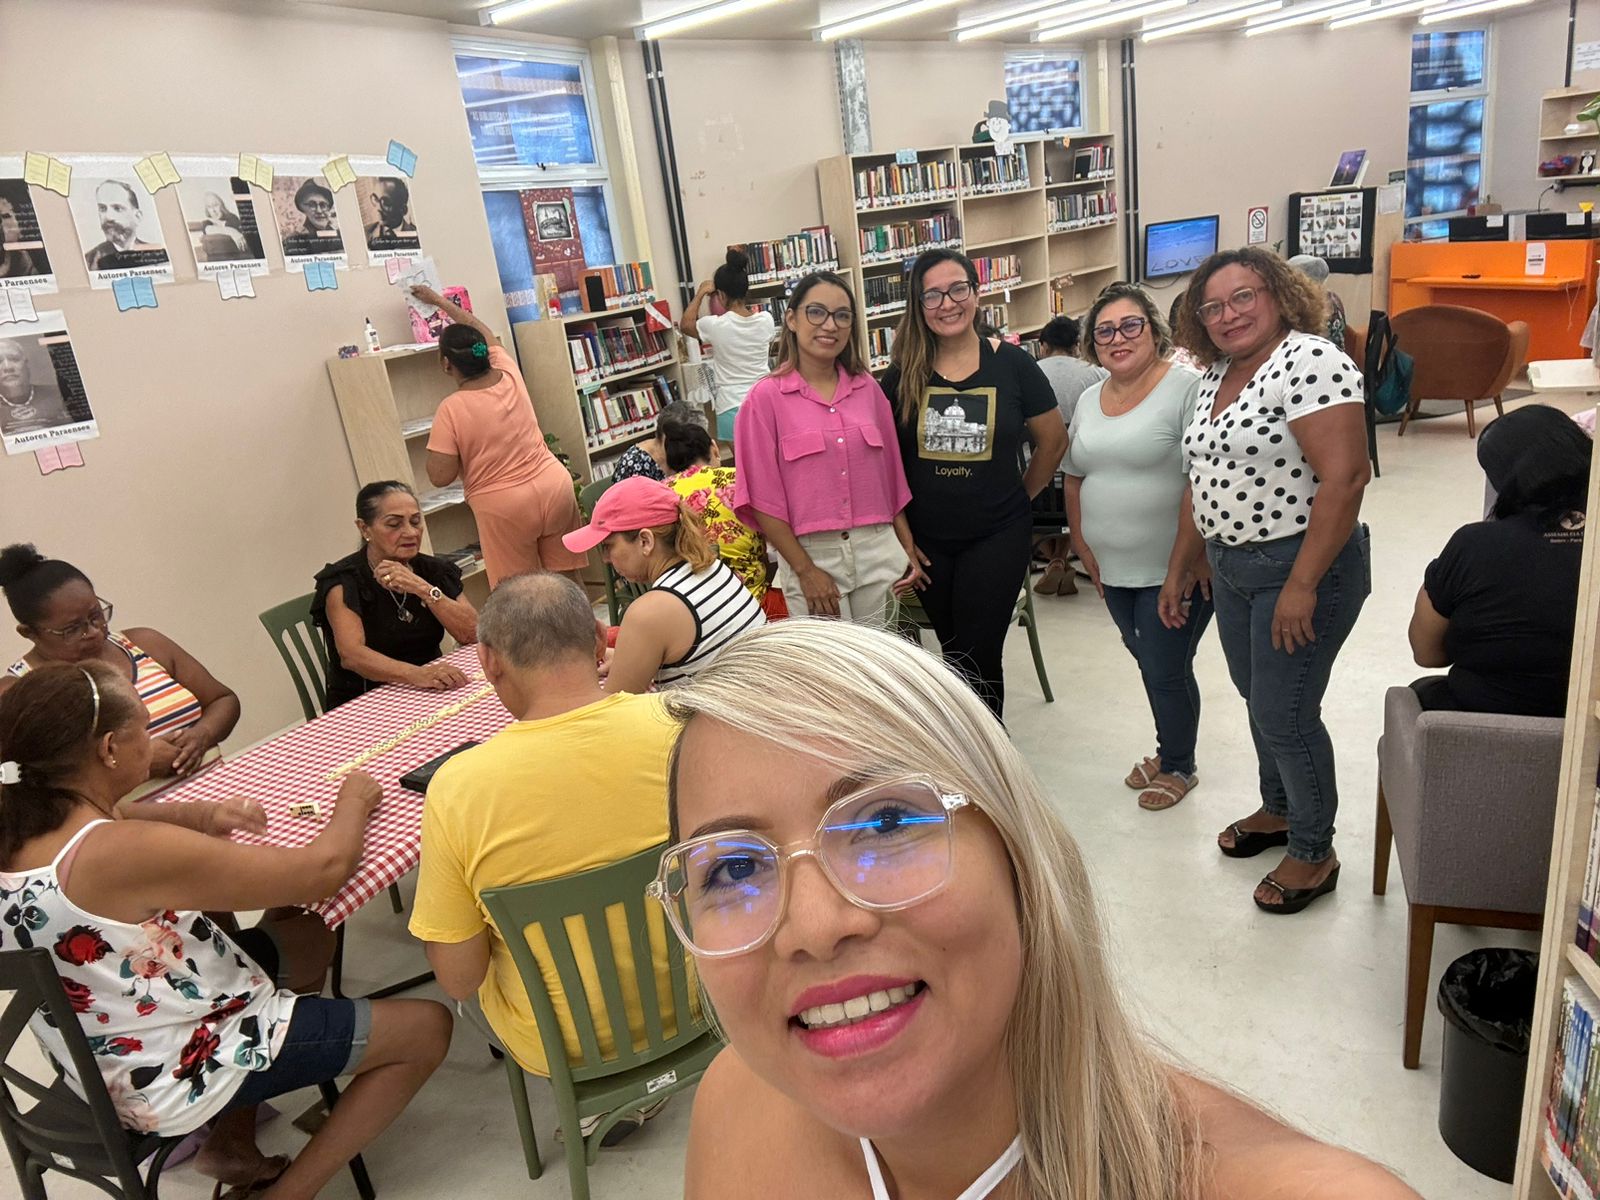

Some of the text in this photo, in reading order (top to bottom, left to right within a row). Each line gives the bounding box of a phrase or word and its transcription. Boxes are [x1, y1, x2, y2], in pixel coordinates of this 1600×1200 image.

[290, 255, 343, 264] Autores Paraenses
[395, 250, 418, 258] Paraenses
[203, 261, 262, 272] Autores Paraenses
[97, 267, 168, 280] Autores Paraenses
[4, 277, 48, 287] Paraenses
[14, 424, 91, 445] Autores Paraenses
[935, 466, 973, 477] Loyalty.
